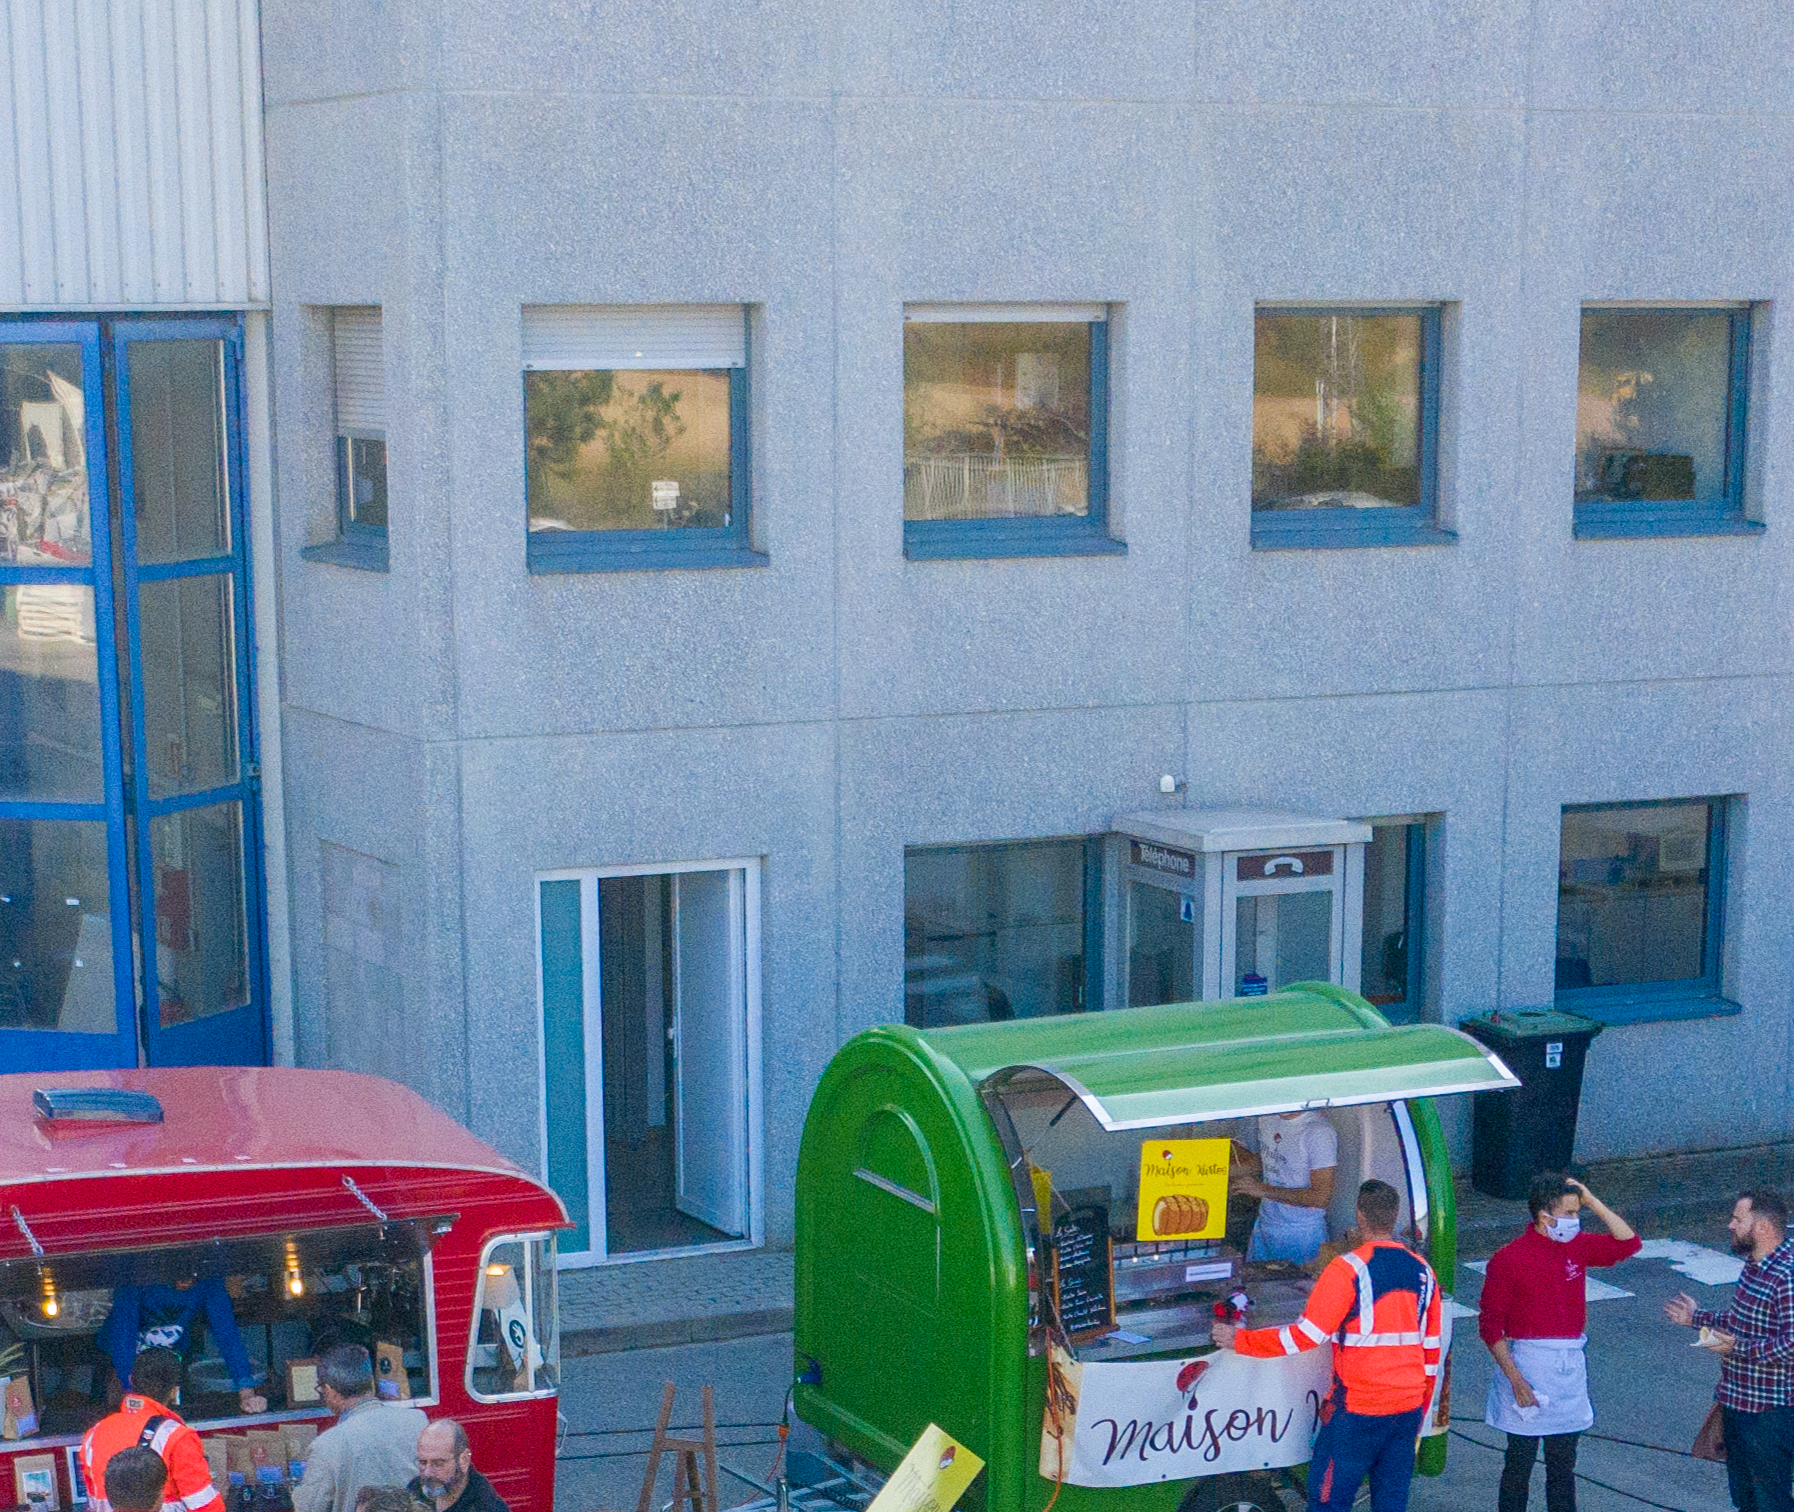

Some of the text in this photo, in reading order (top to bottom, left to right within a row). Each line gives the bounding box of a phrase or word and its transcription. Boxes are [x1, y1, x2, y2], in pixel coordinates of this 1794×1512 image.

[1139, 843, 1189, 873] Téléphone
[1145, 1161, 1192, 1179] Maison
[1090, 1398, 1294, 1467] Maison
